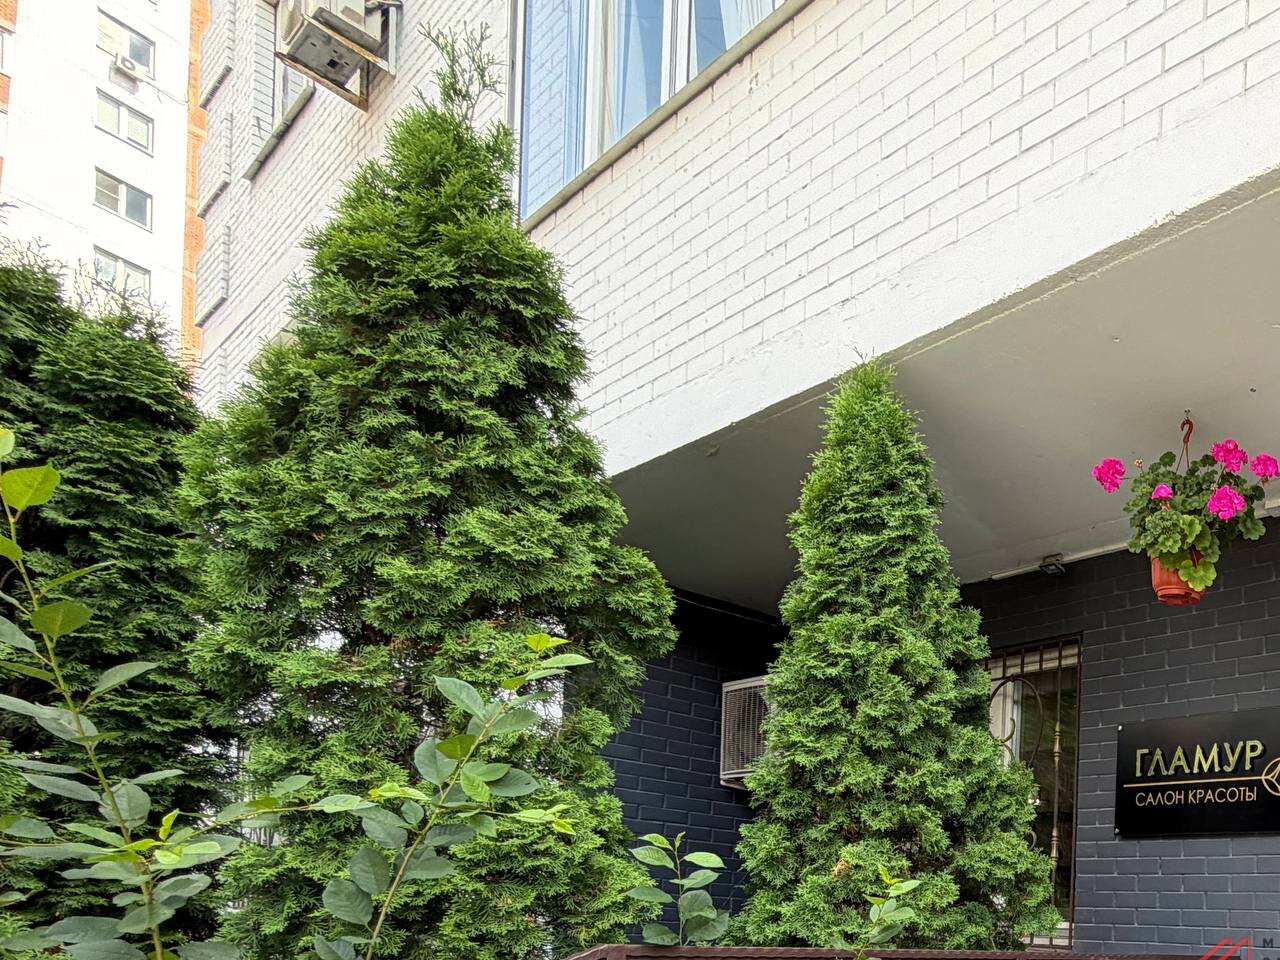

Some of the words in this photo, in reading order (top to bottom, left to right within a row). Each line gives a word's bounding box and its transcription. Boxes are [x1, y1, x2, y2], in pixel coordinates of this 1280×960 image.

[1136, 740, 1264, 777] ГЛАМУР
[1135, 790, 1185, 806] САЛОН
[1188, 786, 1257, 803] КРАСОТЫ
